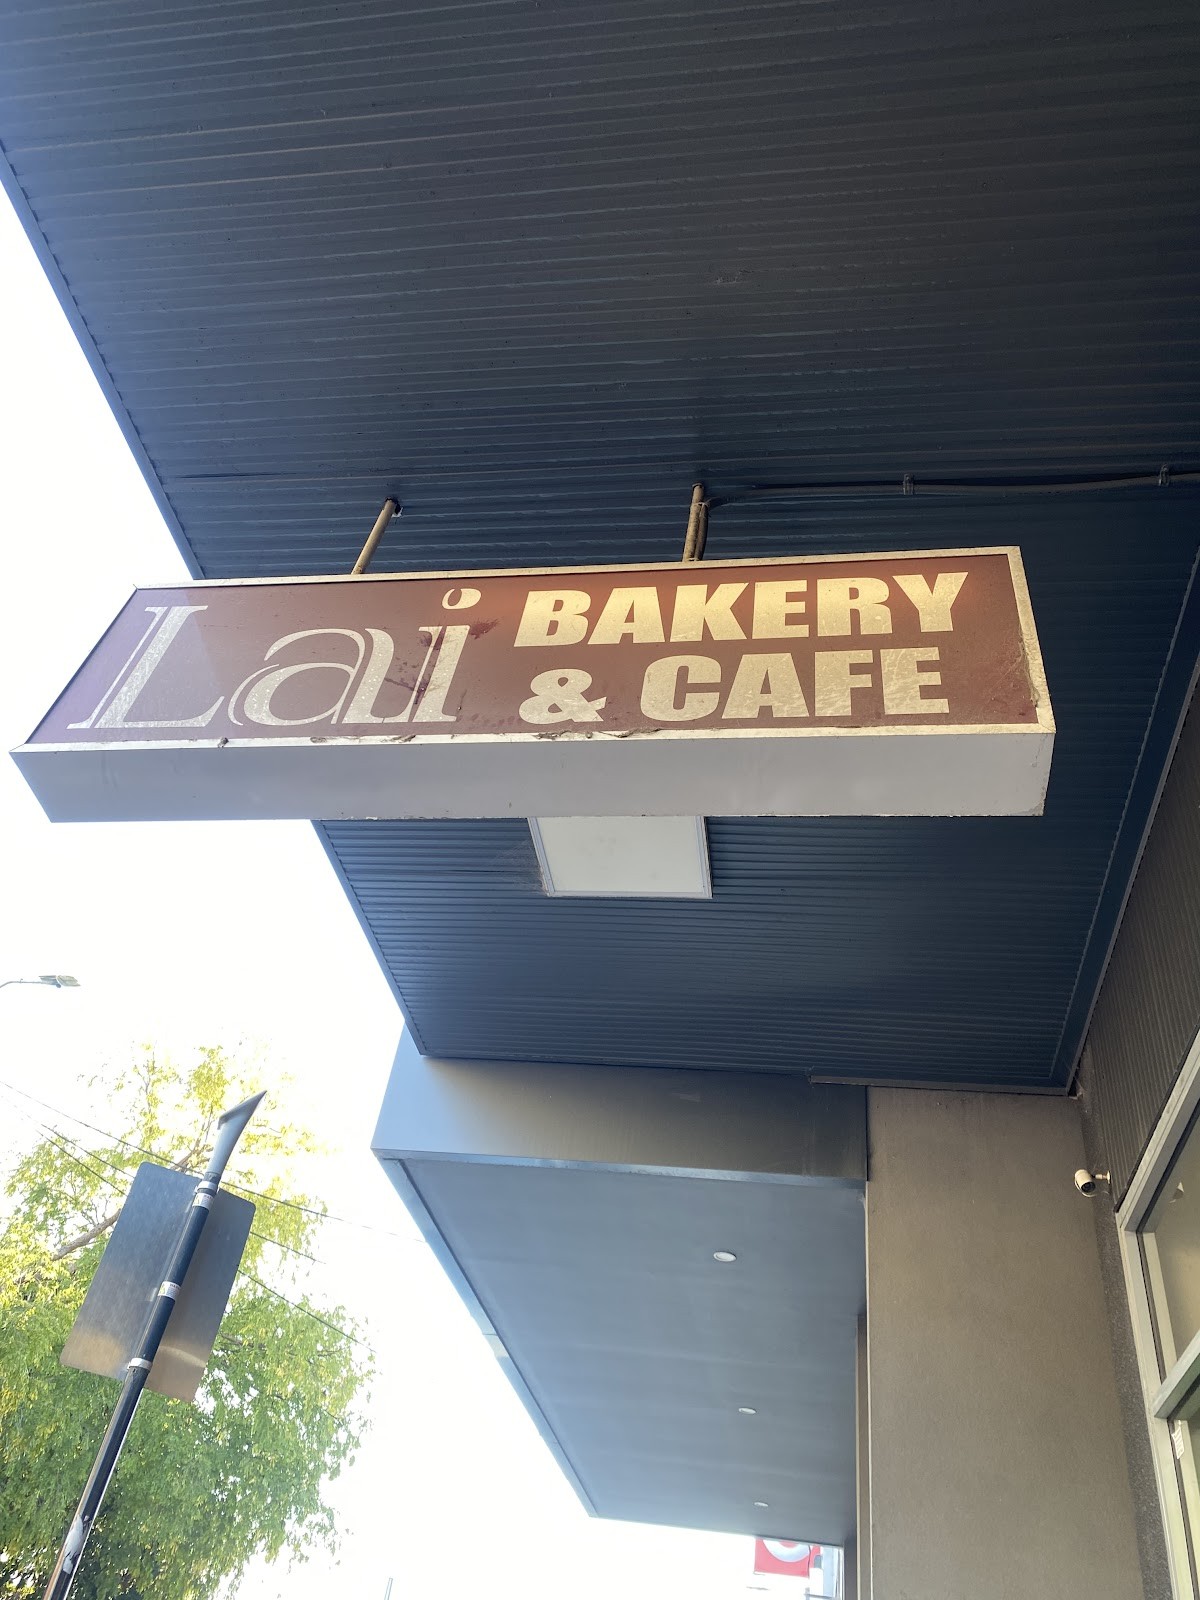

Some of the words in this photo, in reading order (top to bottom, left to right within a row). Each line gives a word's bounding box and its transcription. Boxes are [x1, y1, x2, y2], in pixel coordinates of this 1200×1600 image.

[513, 571, 969, 648] BAKERY
[67, 588, 482, 729] Lai
[518, 668, 607, 726] &
[640, 646, 950, 723] CAFE
